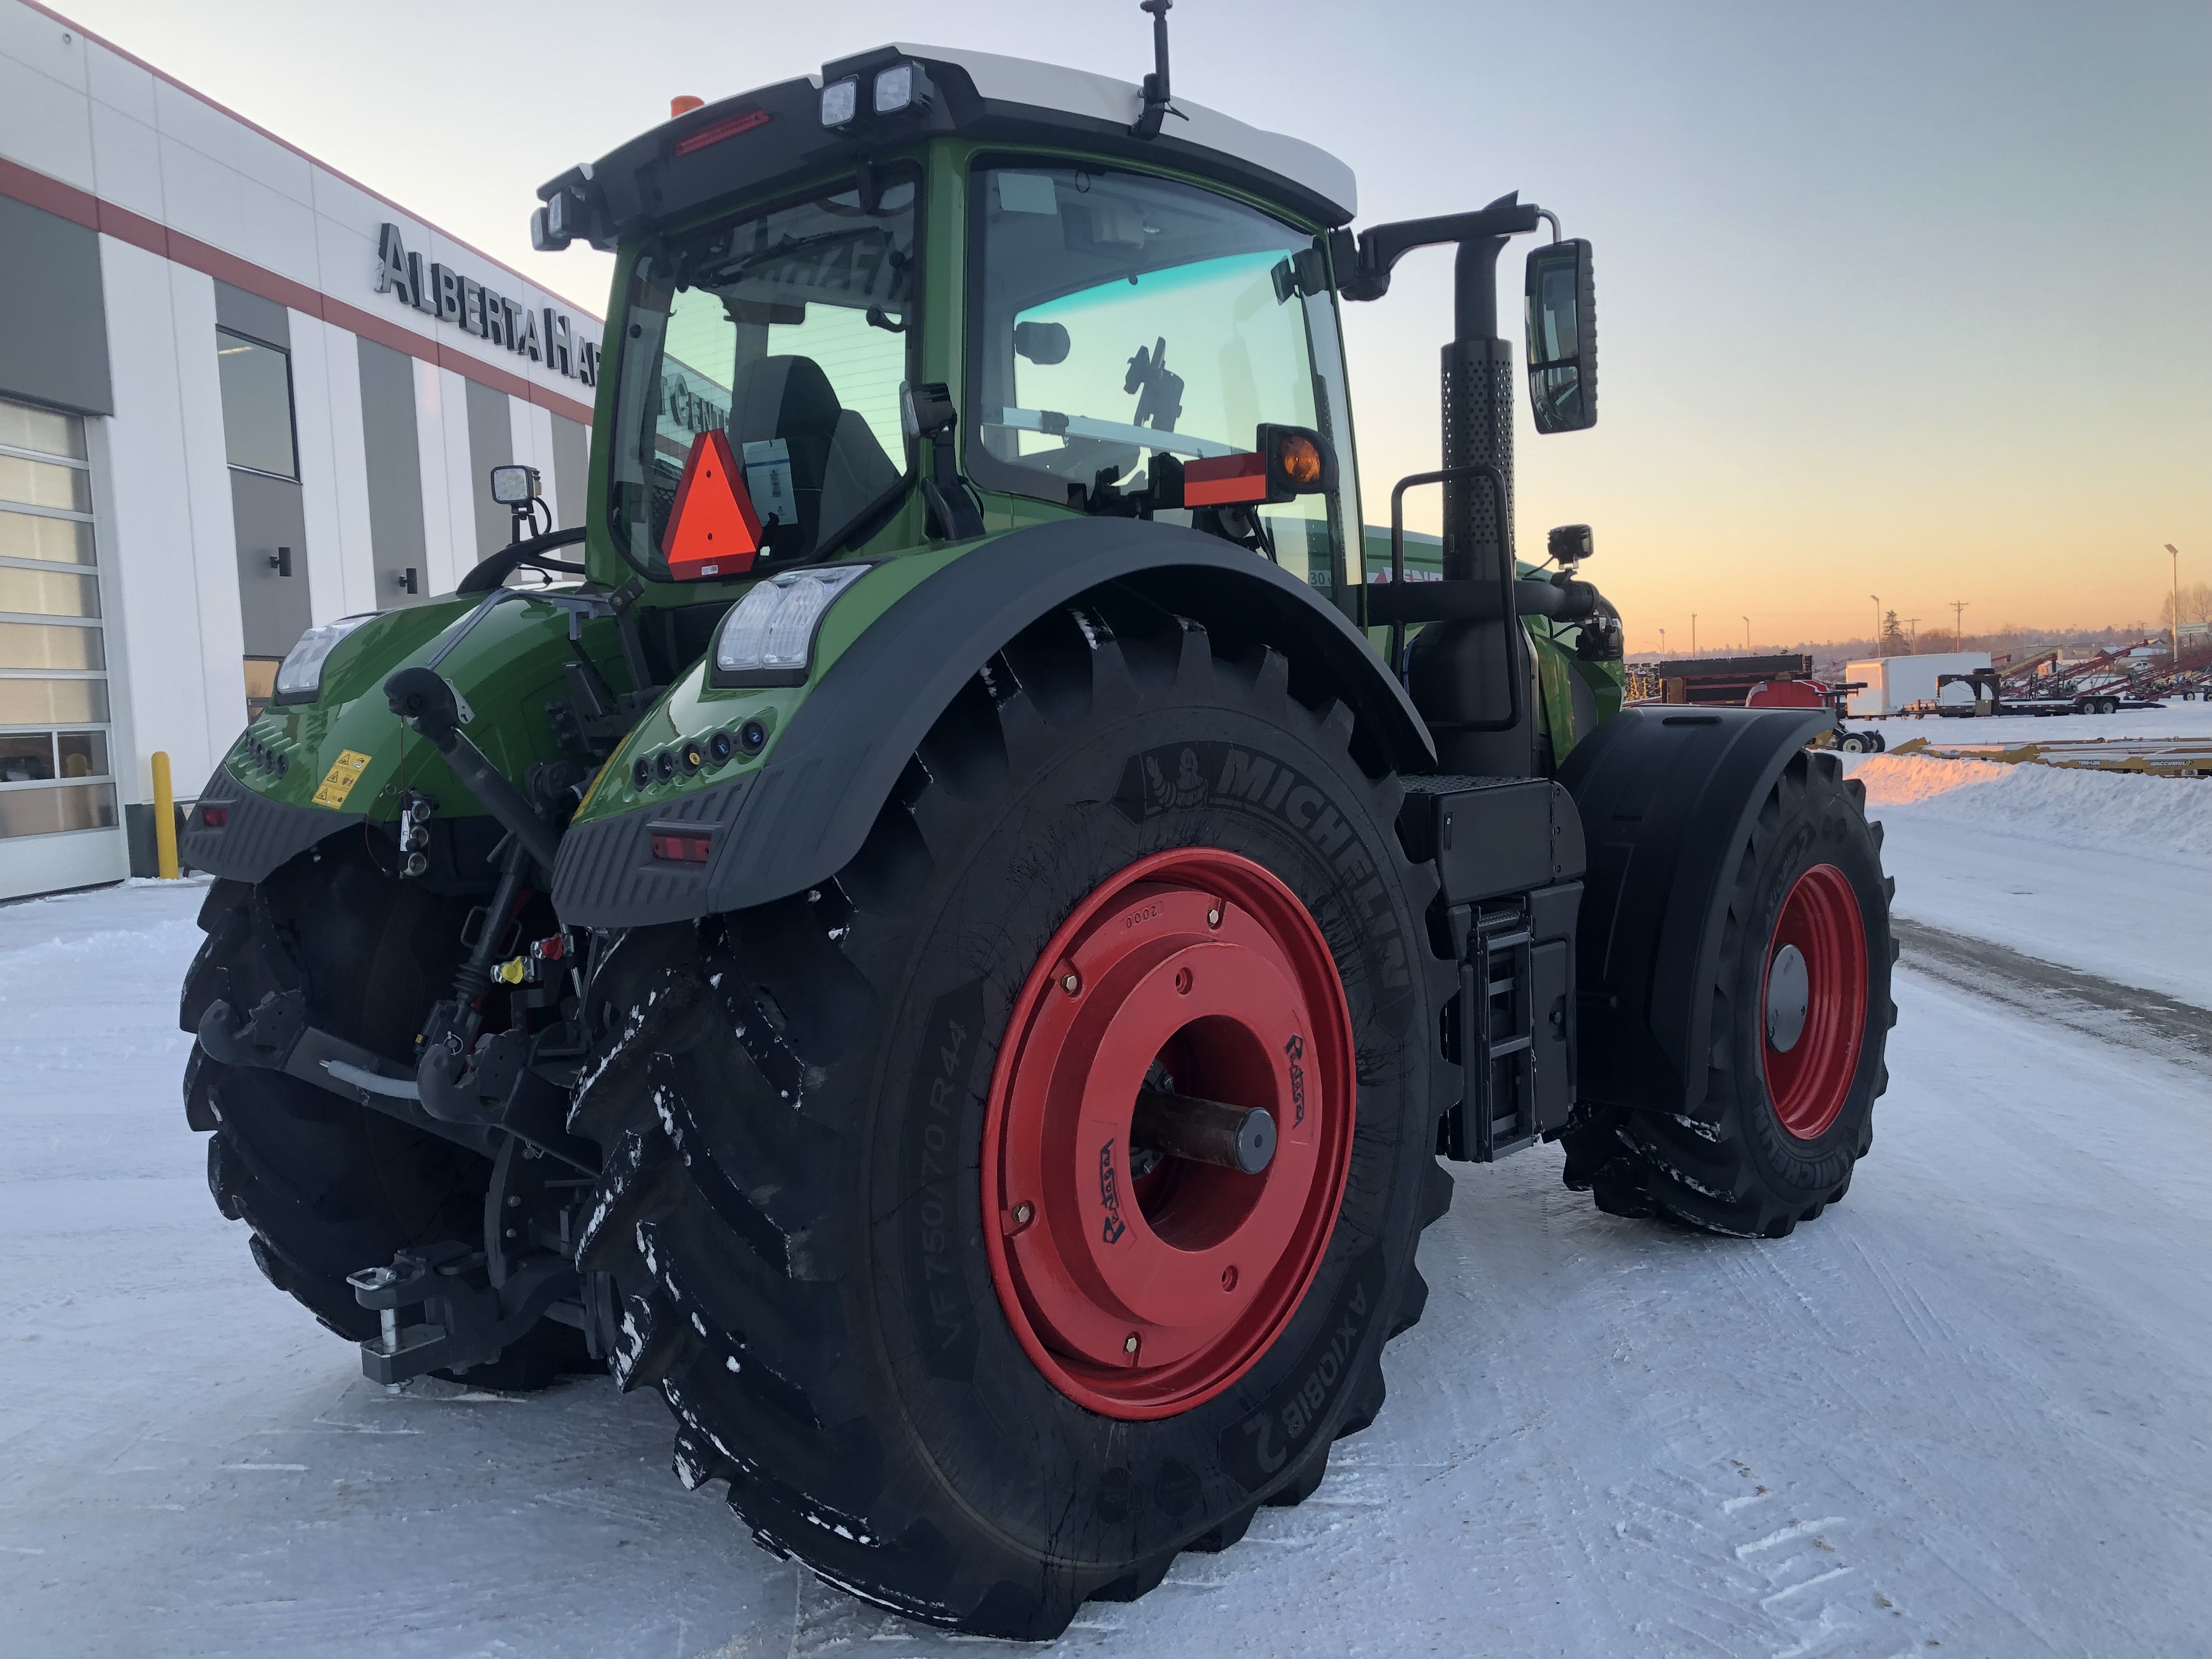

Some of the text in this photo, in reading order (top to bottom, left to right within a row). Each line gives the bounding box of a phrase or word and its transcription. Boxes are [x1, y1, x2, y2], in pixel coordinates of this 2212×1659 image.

[375, 223, 543, 362] ALBERTA
[1126, 906, 1157, 928] 2000
[1216, 748, 1409, 988] MICHELIN
[921, 1122, 950, 1282] 750/70
[928, 1289, 962, 1350] VF
[1242, 1281, 1367, 1474] AXIOBIB 2
